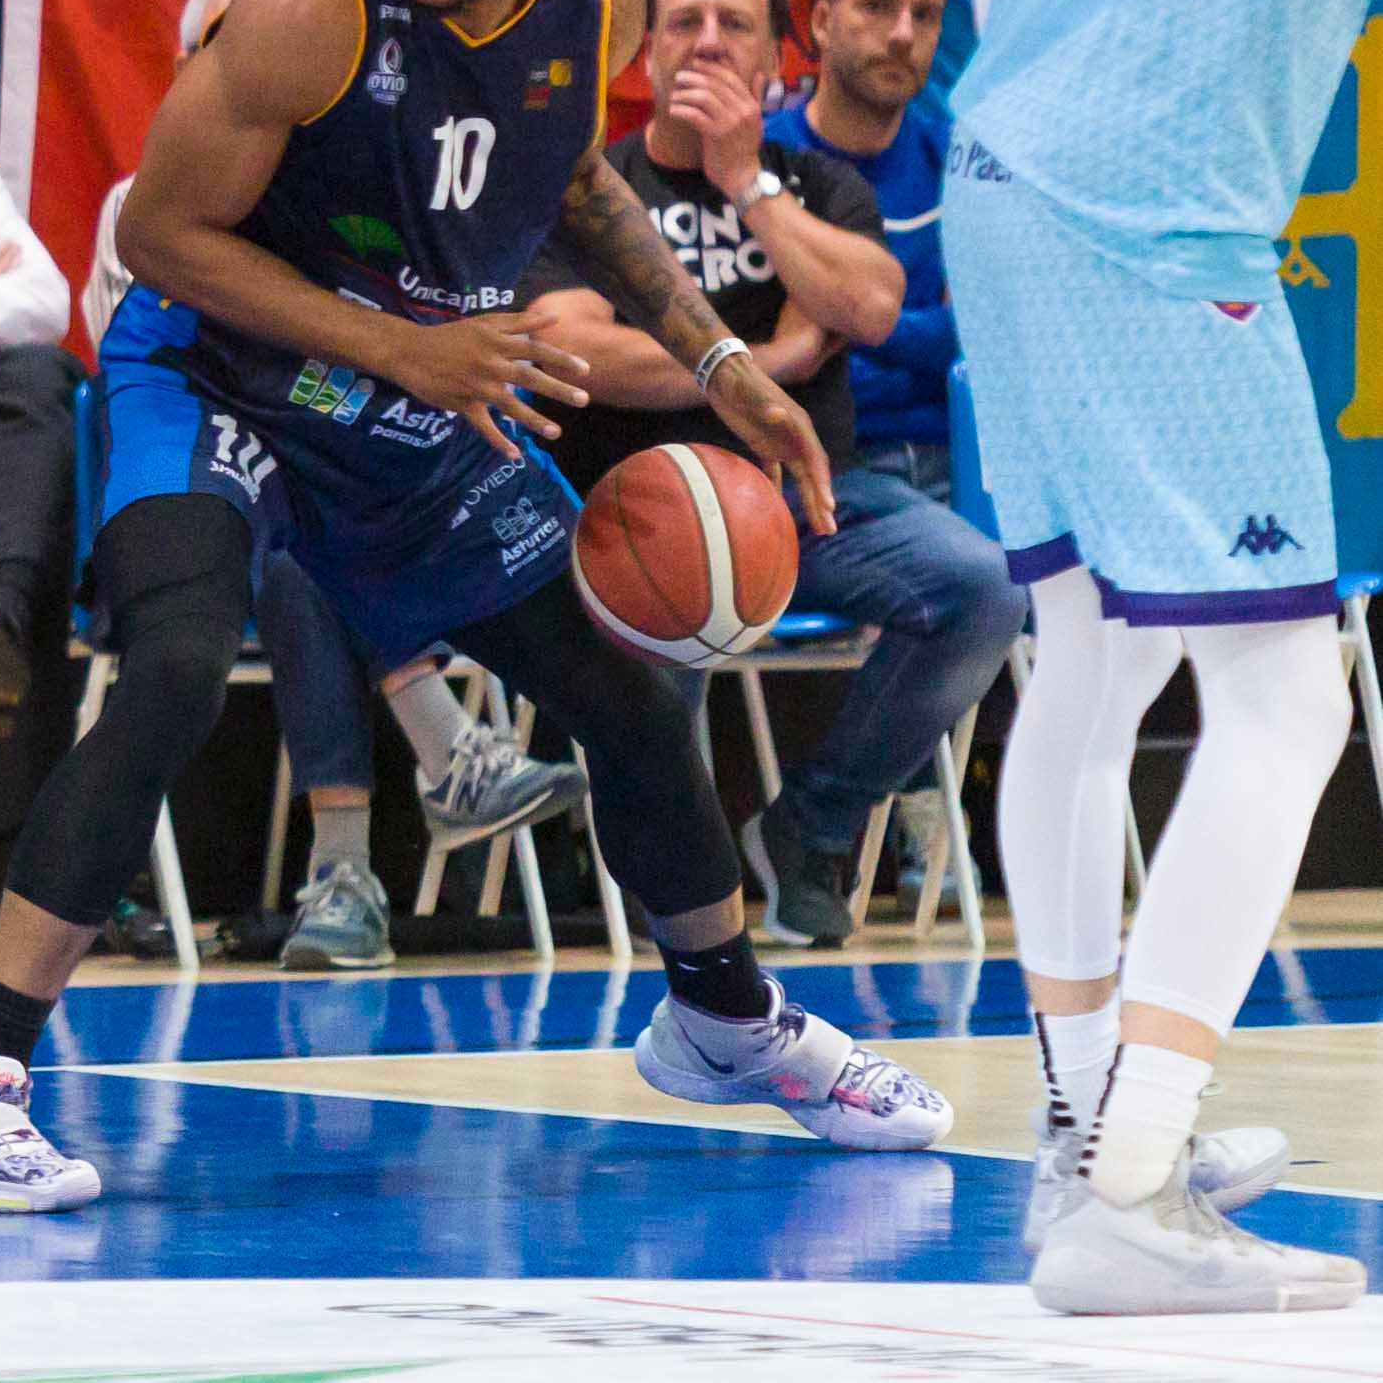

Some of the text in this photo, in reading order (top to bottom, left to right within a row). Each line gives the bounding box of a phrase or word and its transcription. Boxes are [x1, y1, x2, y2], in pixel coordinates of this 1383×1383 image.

[429, 115, 497, 211] 10
[464, 455, 526, 505] OVIEDO
[501, 516, 559, 565] Asturias
